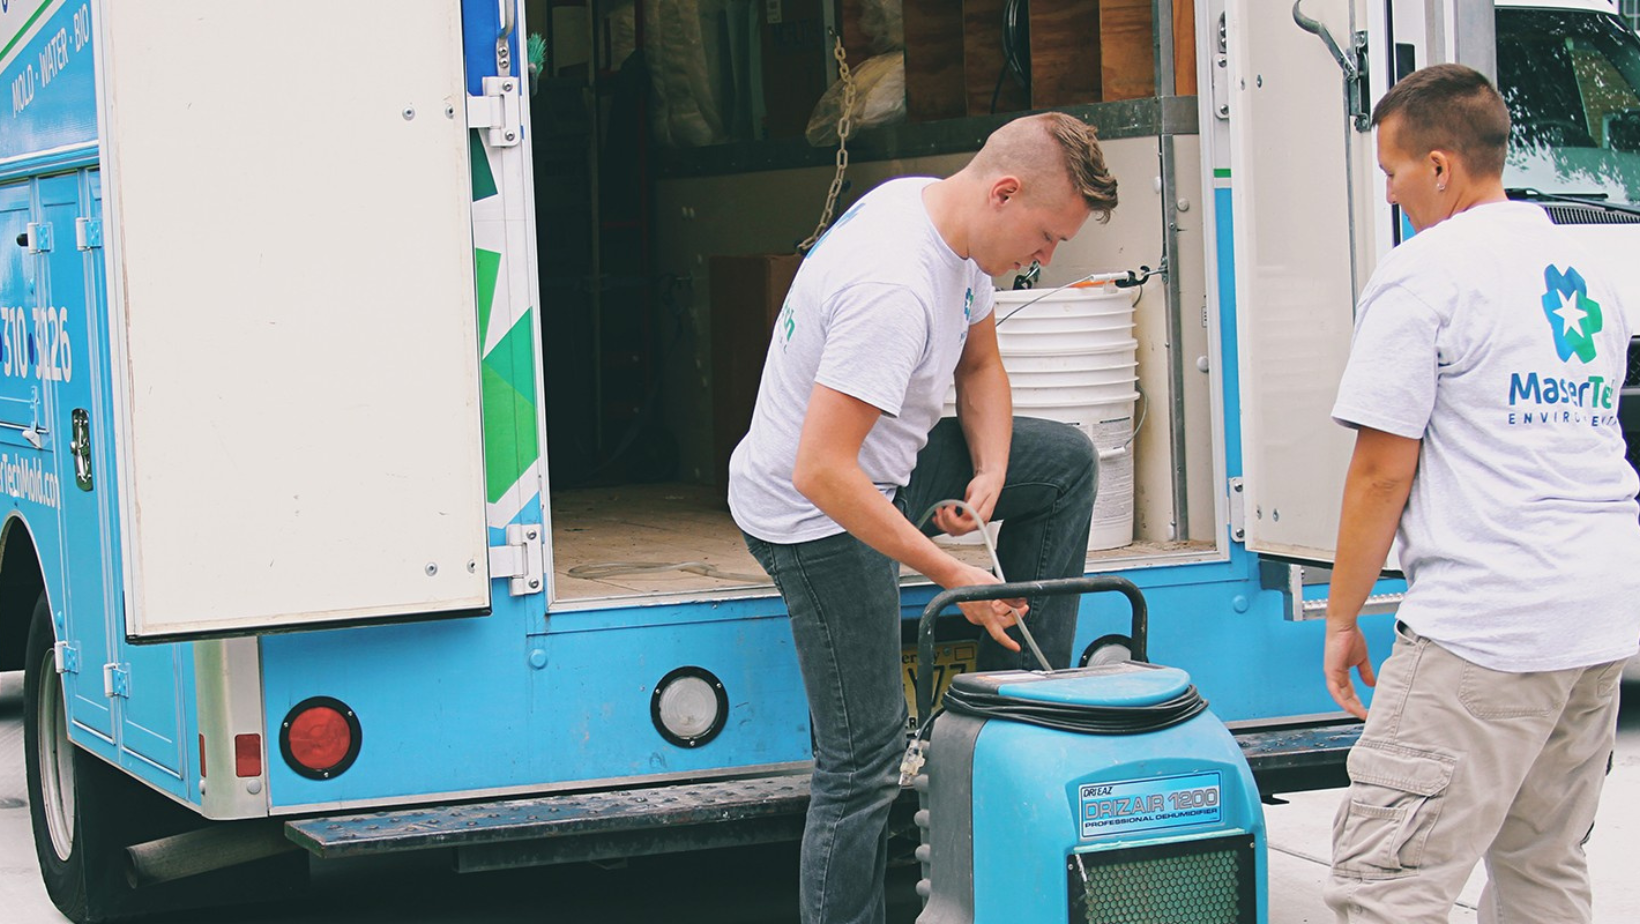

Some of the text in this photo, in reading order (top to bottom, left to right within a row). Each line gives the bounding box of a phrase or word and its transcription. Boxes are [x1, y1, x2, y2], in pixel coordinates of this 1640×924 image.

[11, 3, 90, 119] MOLD WATER BIO
[1508, 371, 1614, 410] MaserTe
[1085, 788, 1218, 819] DRIZAIR 1200
[1085, 808, 1218, 828] PROFESSIONAL DEHUMIDIFIER
